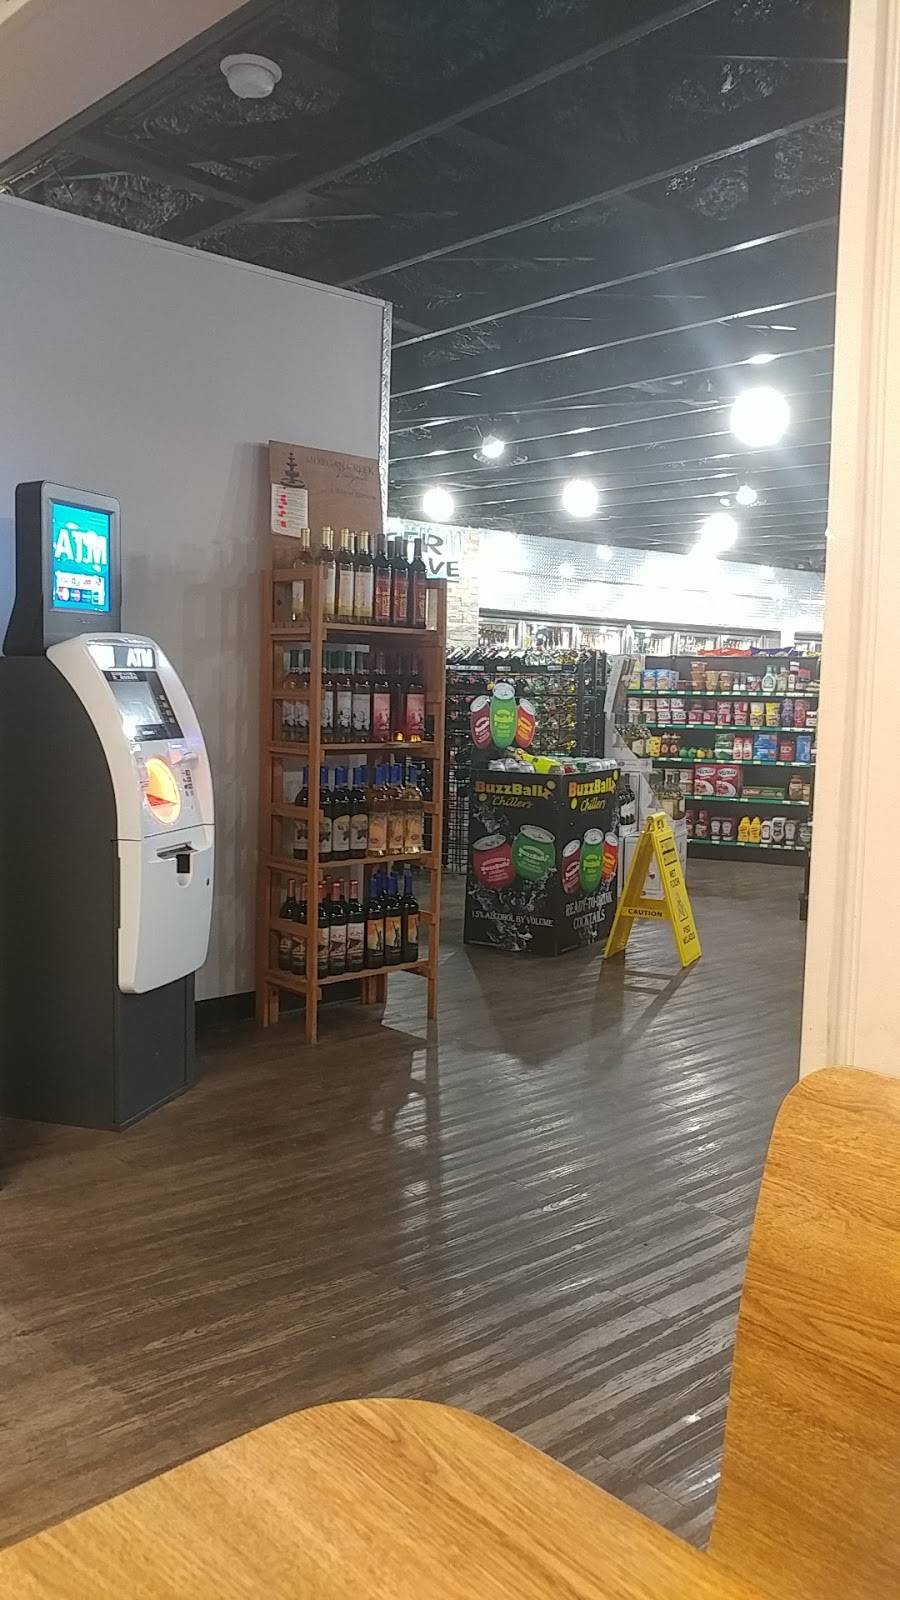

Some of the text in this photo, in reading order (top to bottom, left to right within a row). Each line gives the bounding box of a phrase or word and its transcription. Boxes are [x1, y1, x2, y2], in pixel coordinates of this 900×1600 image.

[54, 528, 107, 565] ATM
[126, 648, 154, 667] ATM
[628, 908, 663, 918] CAUTION
